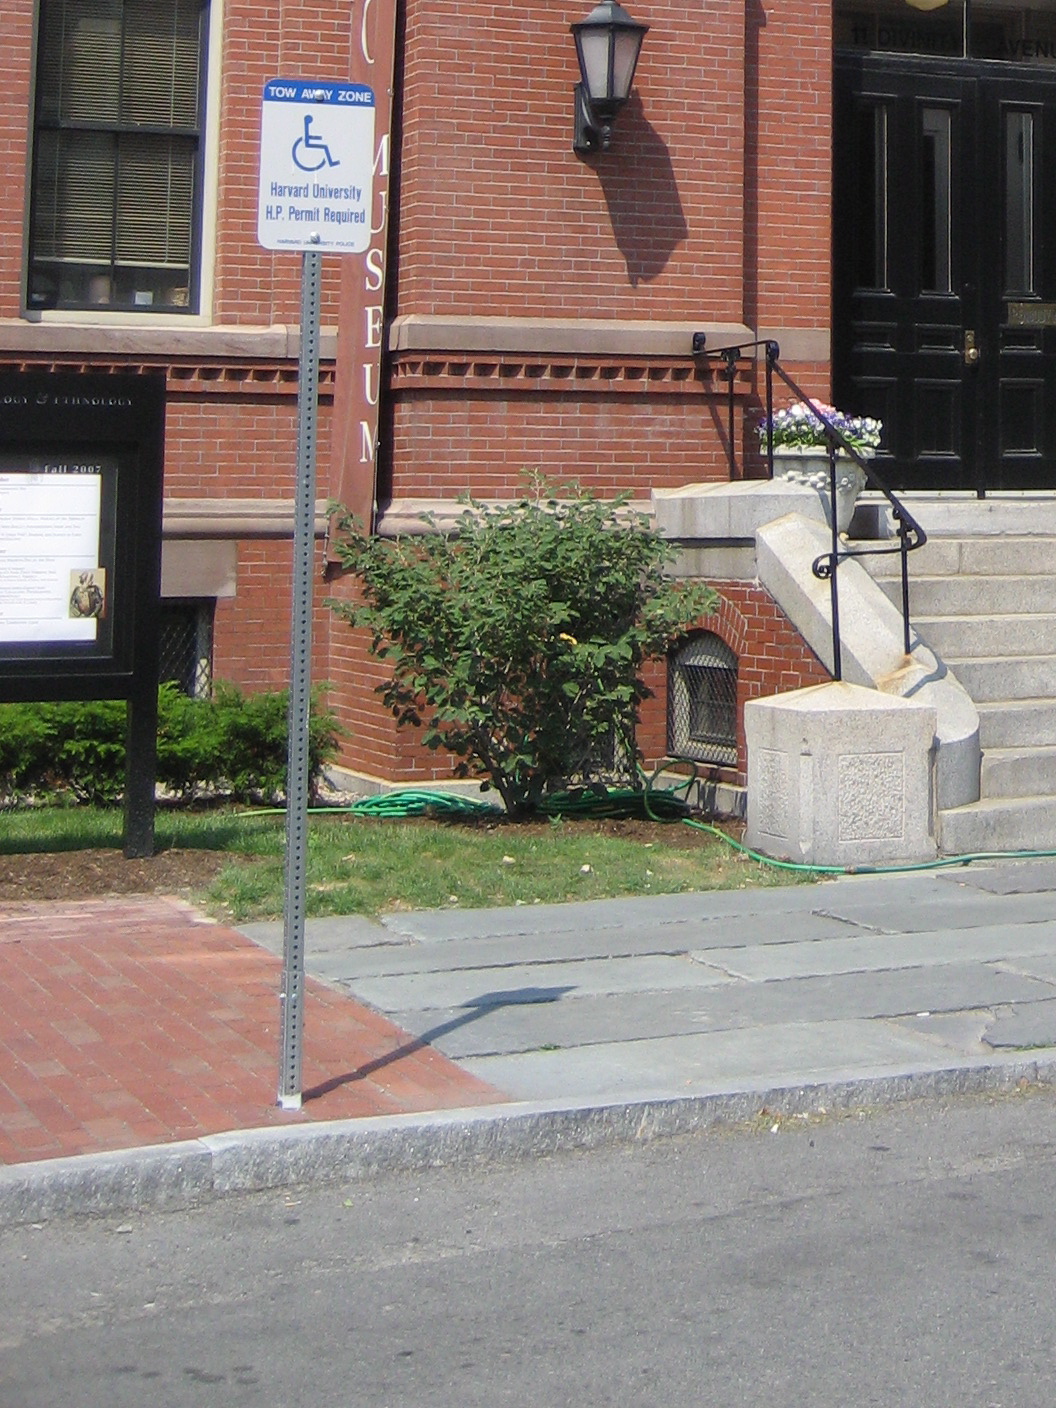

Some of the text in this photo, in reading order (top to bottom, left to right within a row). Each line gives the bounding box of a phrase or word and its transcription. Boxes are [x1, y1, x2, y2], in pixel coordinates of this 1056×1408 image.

[268, 86, 372, 103] TOW AWY ZONE
[270, 181, 362, 202] Harvard University
[265, 205, 366, 225] H.P. Permit Required
[44, 464, 102, 473] fall 2007
